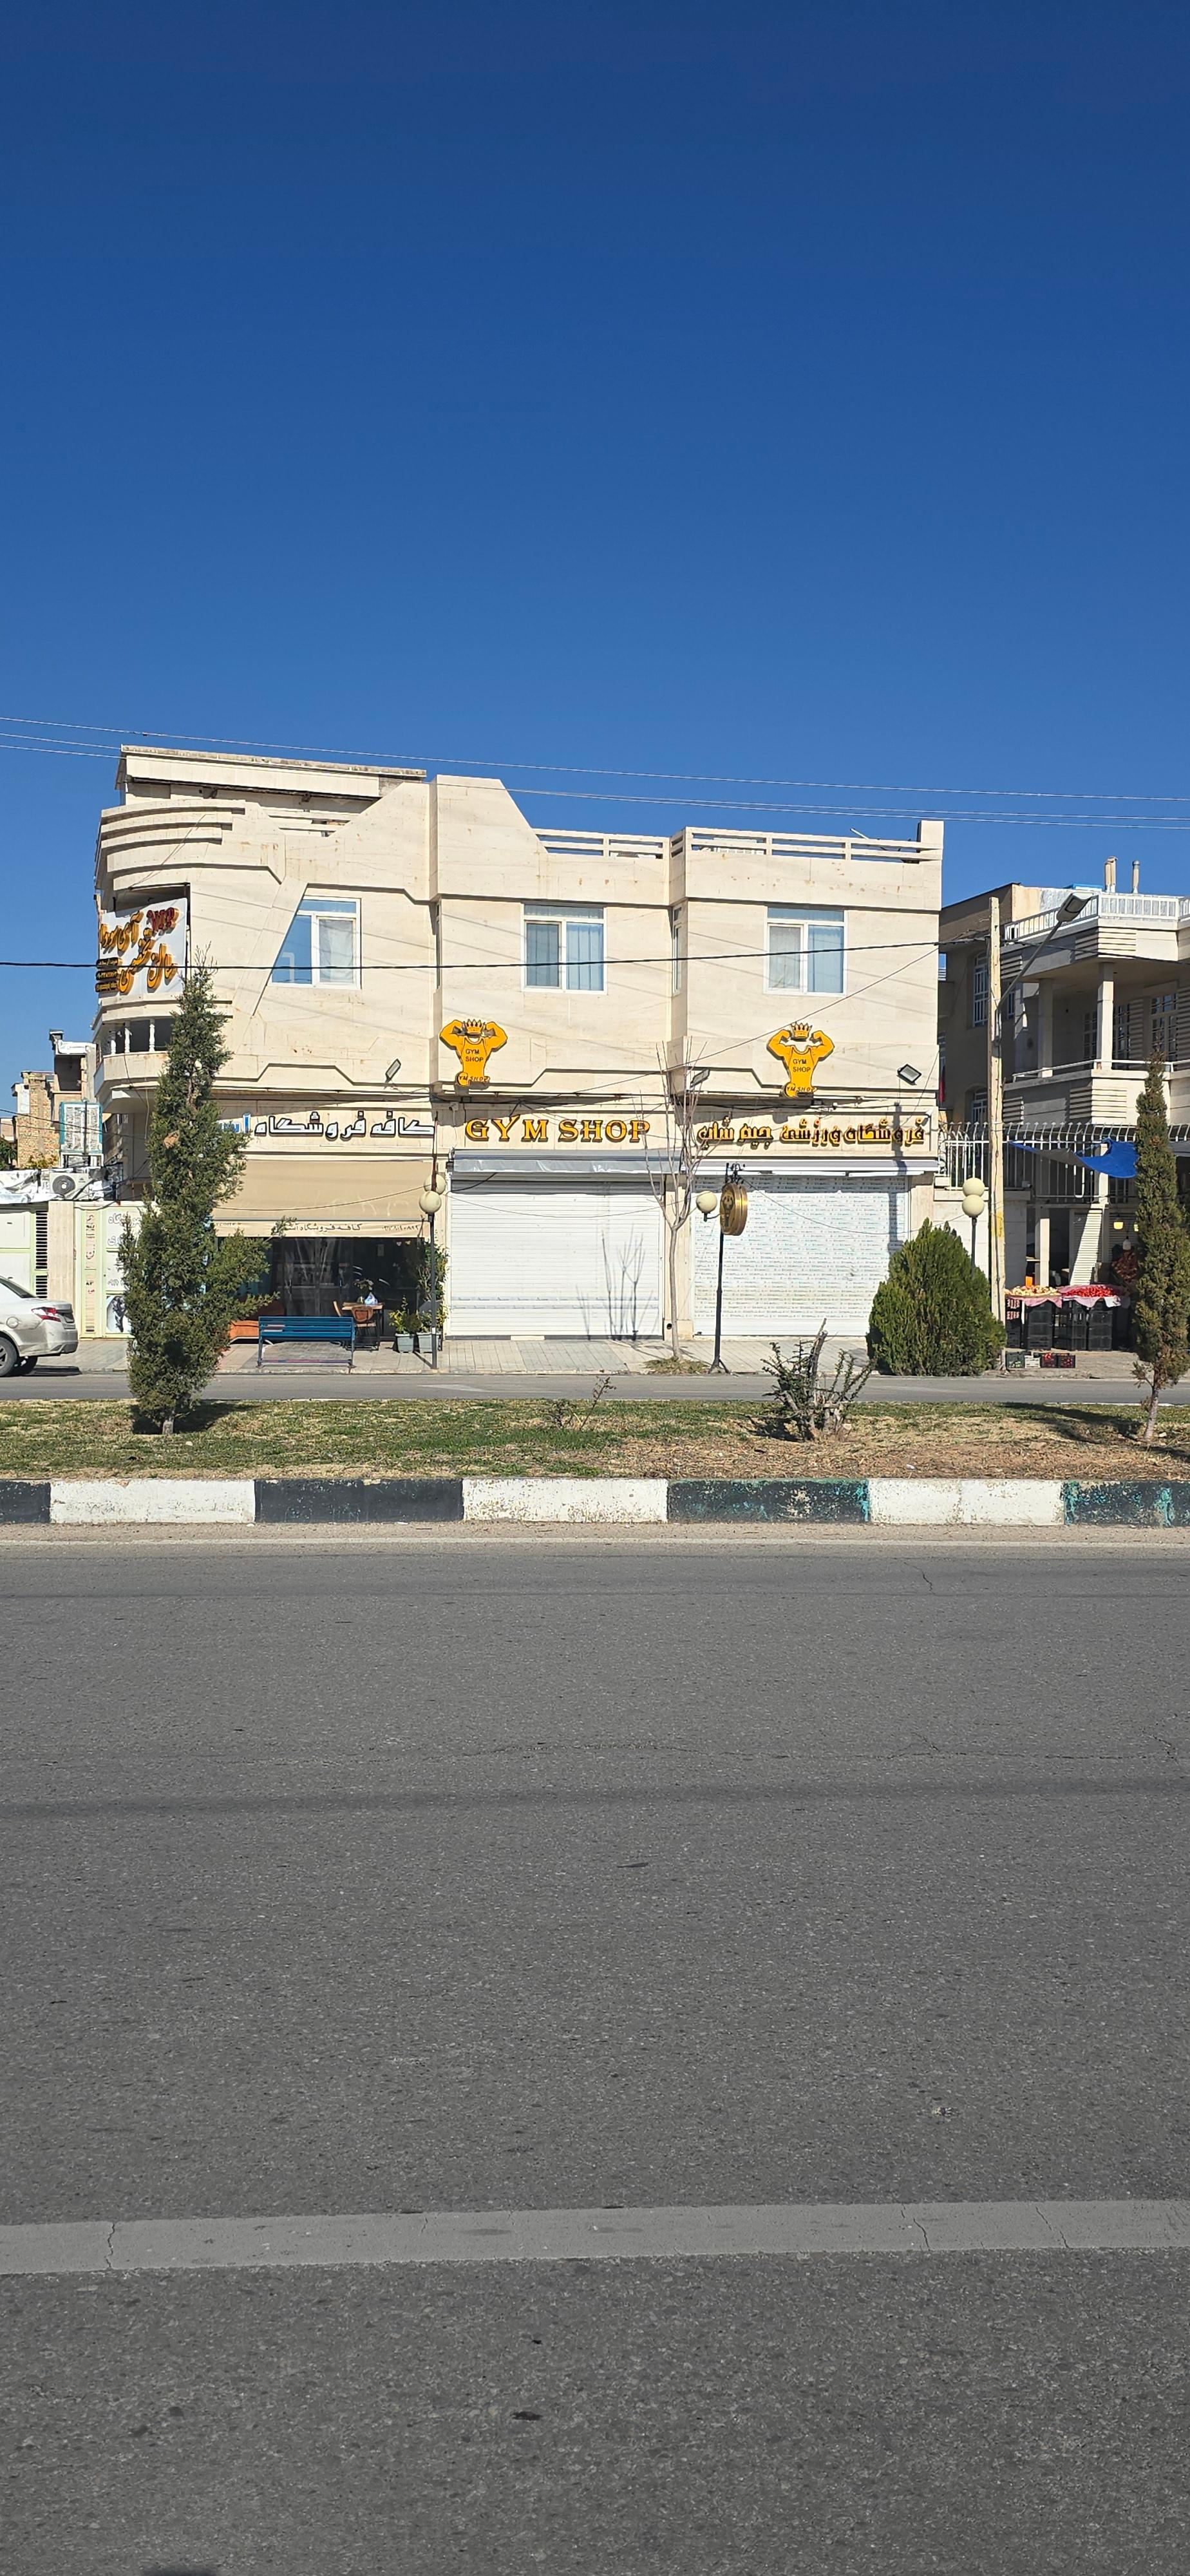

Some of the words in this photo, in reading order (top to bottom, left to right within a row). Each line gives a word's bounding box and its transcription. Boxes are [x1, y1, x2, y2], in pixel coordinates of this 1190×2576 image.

[254, 1112, 367, 1140] فروشگاه
[370, 1111, 435, 1136] کافه
[465, 1115, 549, 1142] GYM
[558, 1119, 650, 1142] SHOP
[737, 1123, 773, 1149] جیم
[844, 1118, 925, 1146] فروشگاه
